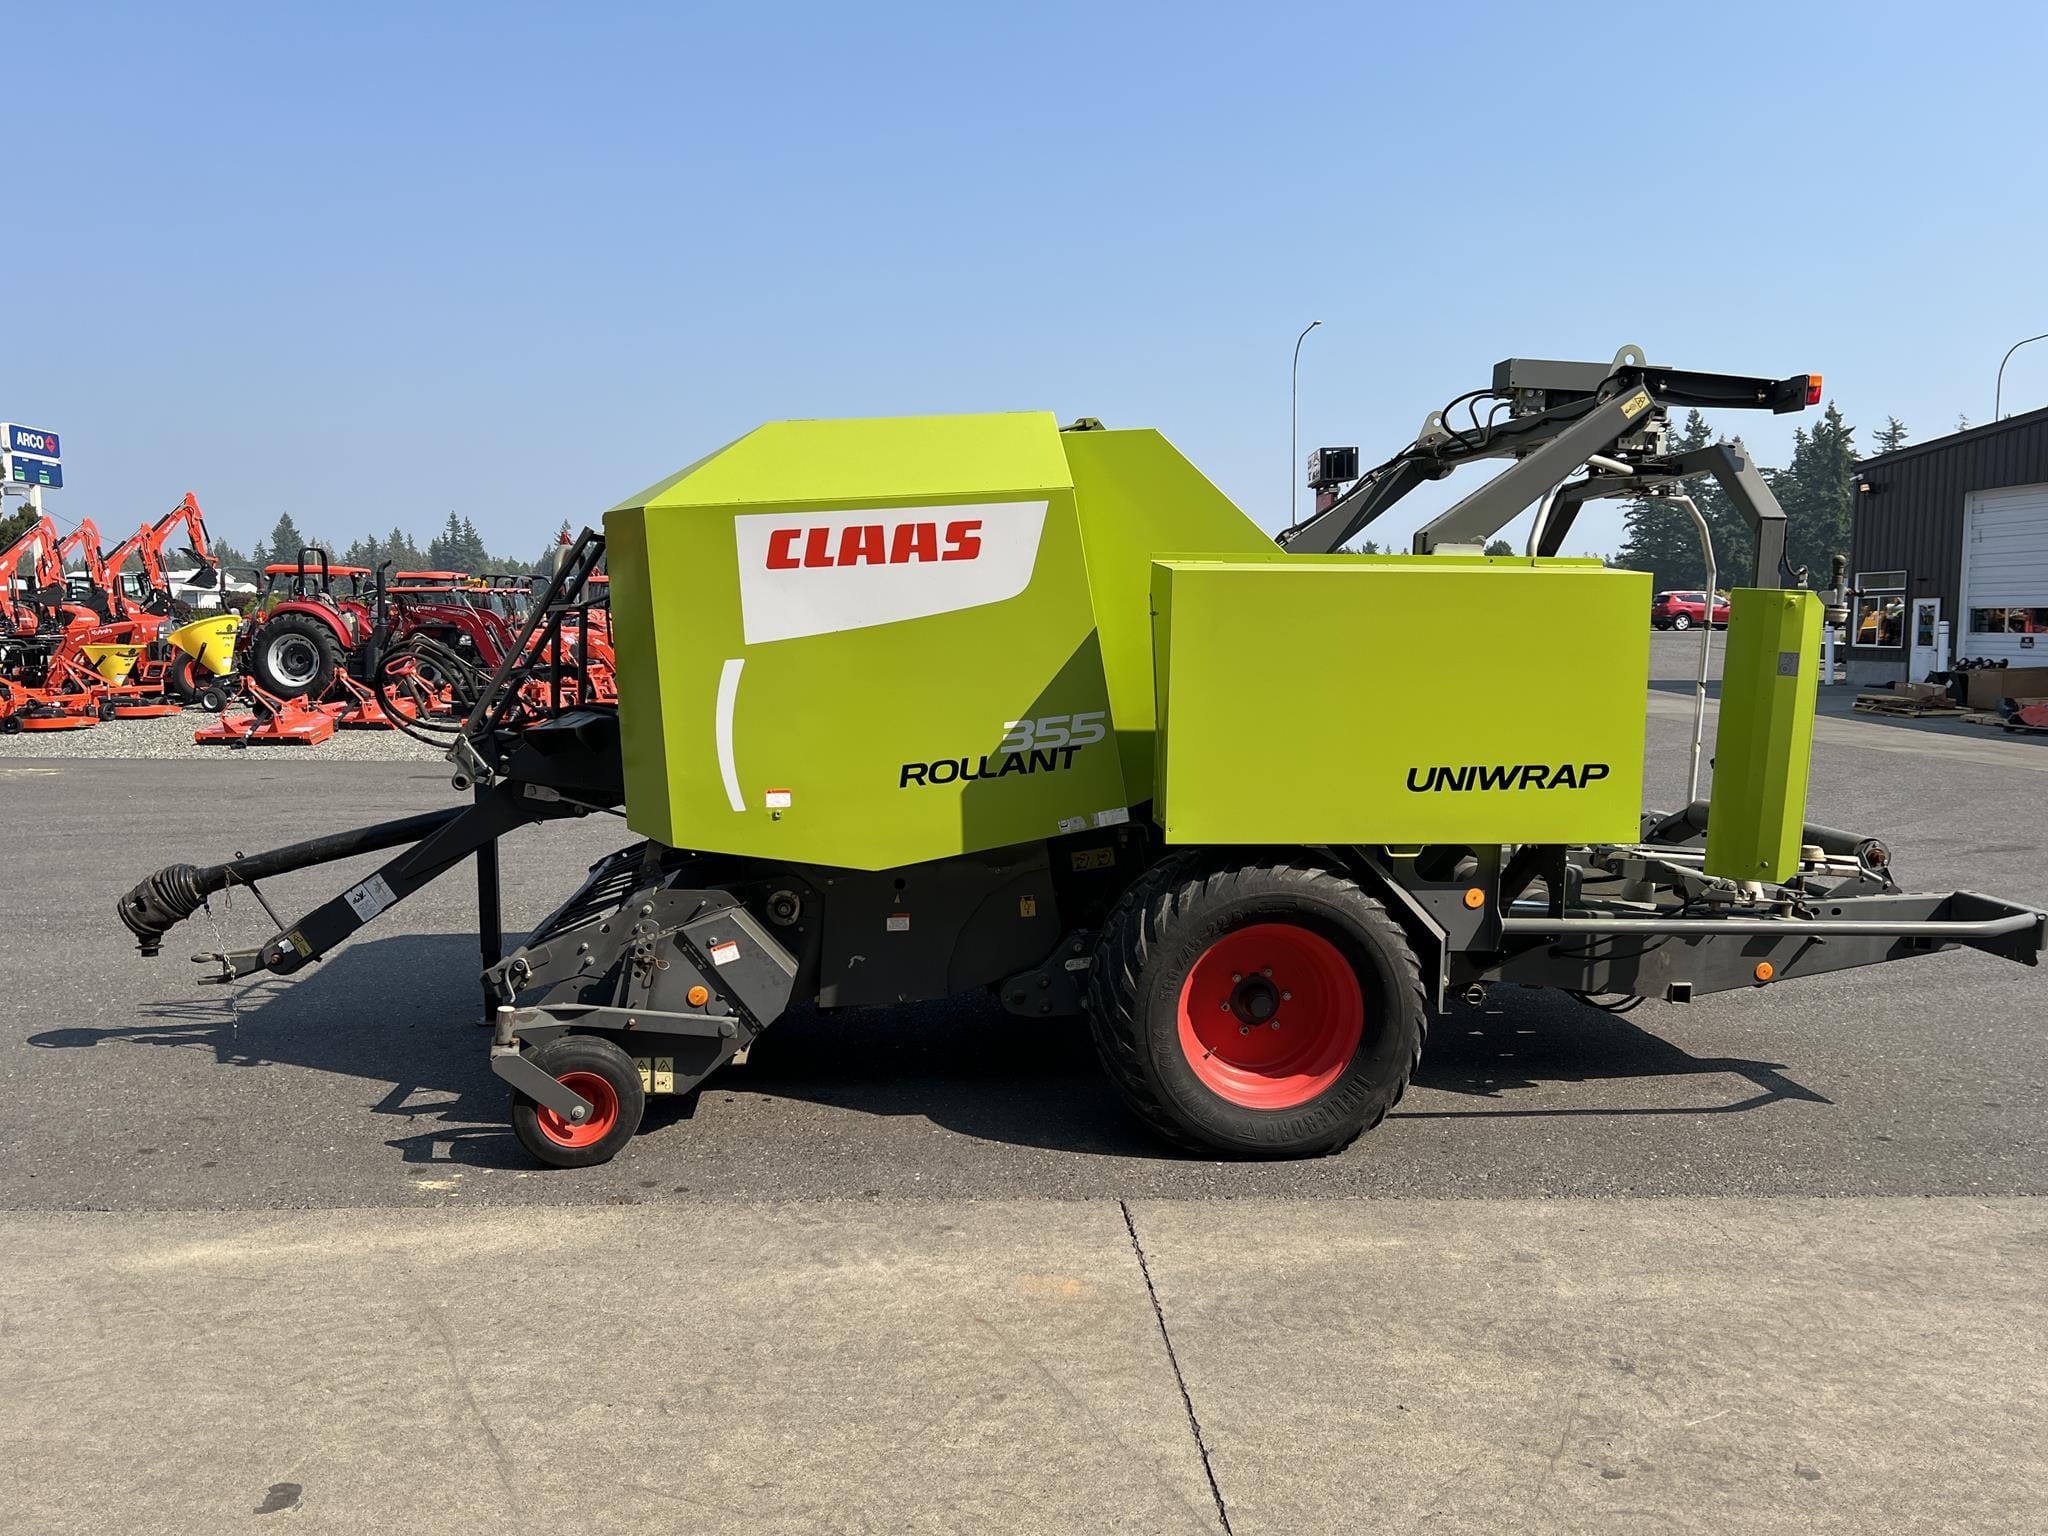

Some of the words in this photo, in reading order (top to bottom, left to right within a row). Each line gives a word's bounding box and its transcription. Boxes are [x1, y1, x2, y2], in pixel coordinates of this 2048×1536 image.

[16, 431, 44, 450] ARCO
[766, 520, 983, 569] CLAAS
[1001, 711, 1106, 753] 355
[899, 745, 1083, 788] ROLLANT
[1407, 763, 1609, 793] UNIWRAP
